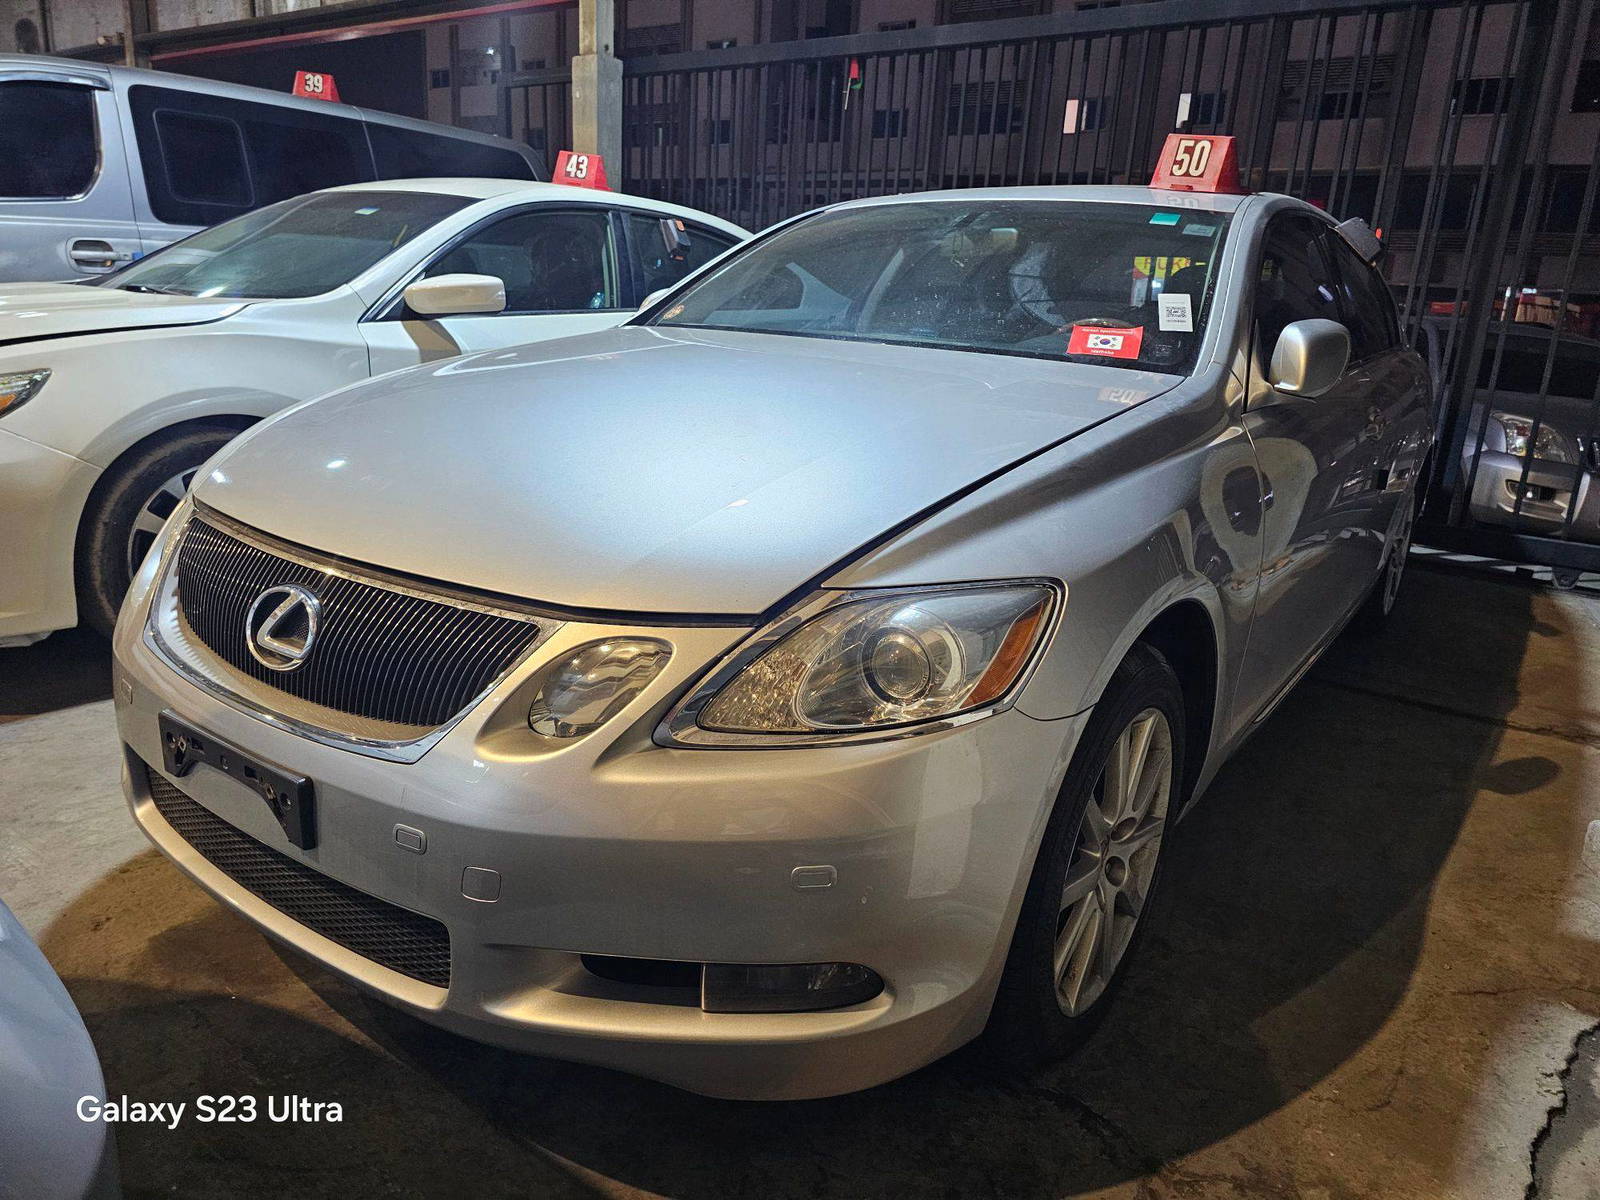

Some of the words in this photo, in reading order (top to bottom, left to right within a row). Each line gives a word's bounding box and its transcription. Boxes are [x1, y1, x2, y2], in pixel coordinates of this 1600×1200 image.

[304, 73, 323, 93] 39
[566, 154, 589, 179] 43
[1172, 139, 1212, 177] 50
